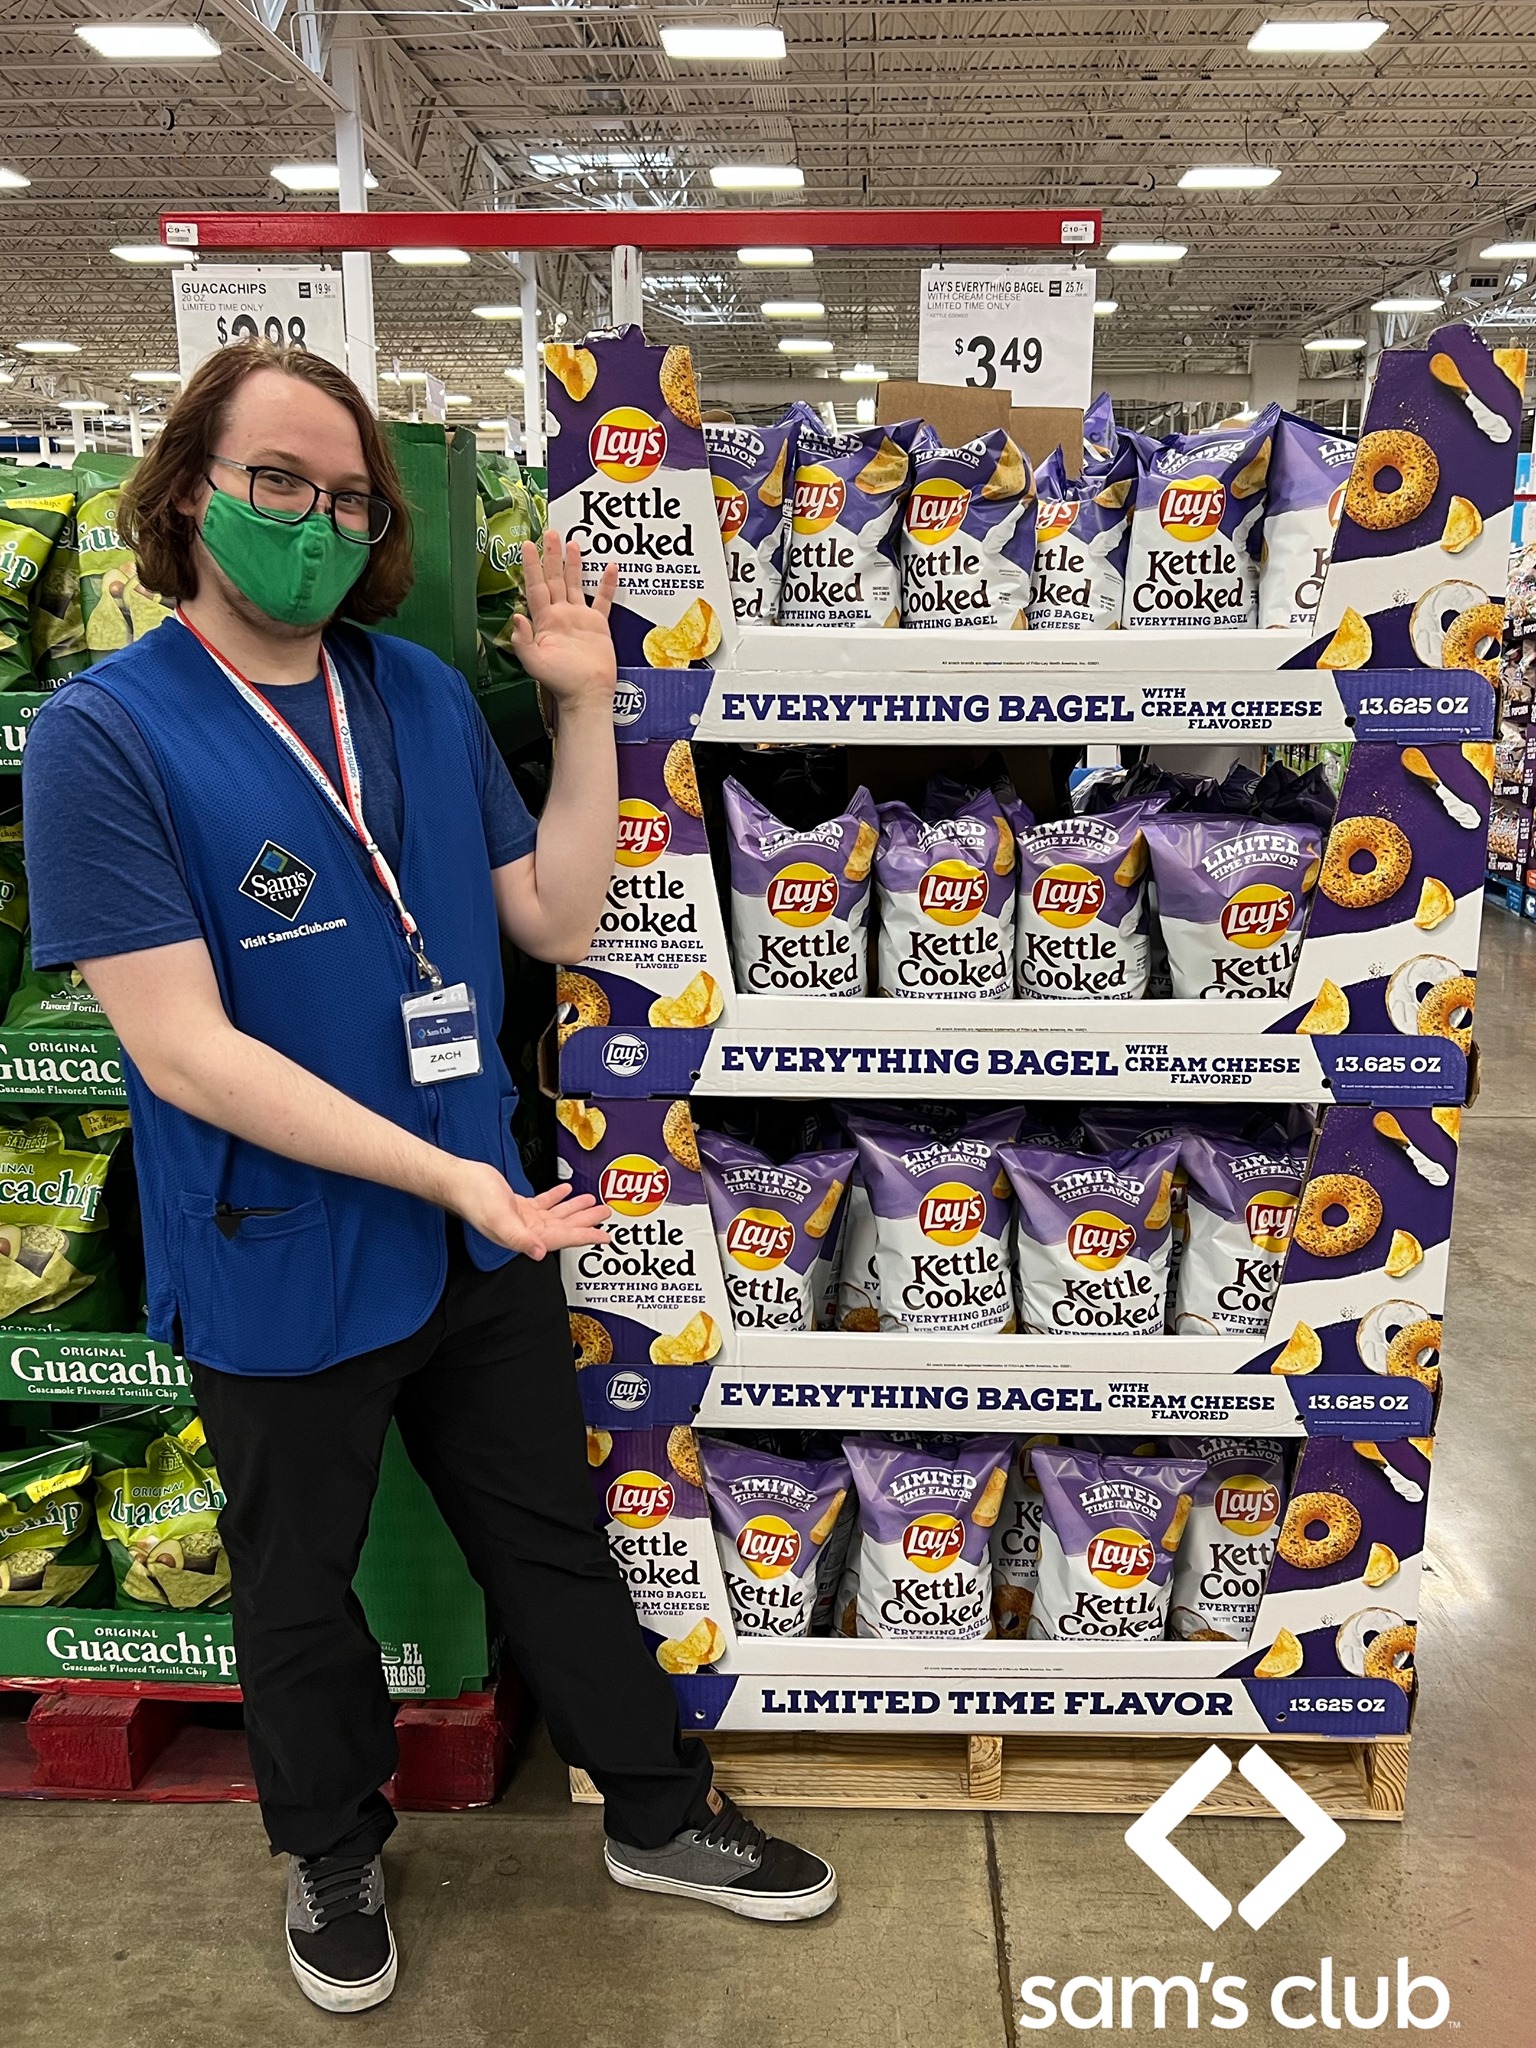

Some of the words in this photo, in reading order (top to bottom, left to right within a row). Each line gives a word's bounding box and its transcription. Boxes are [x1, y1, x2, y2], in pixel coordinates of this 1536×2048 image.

[181, 282, 267, 294] GUACACHIPS
[927, 281, 953, 293] LAY'S
[955, 281, 1012, 293] EVERYTHING
[1014, 282, 1044, 293] BAGEL
[927, 293, 950, 301] WITH
[952, 293, 984, 301] CREAM
[985, 293, 1021, 301] CHEESE
[182, 303, 216, 311] LIMITED
[240, 304, 264, 312] ONLY
[927, 302, 962, 310] LIMITED
[963, 302, 985, 310] TIME
[987, 302, 1011, 310] ONLY
[579, 487, 681, 530] Kettle
[1165, 490, 1224, 527] Lay's
[655, 563, 701, 574] BAGEL
[1147, 545, 1237, 586] Kettle
[652, 578, 705, 590] CHEESE
[1133, 577, 1244, 613] Cooked
[831, 609, 872, 620] BAGEL
[1054, 609, 1095, 622] BAGEL
[1129, 615, 1211, 626] EVERYTHING
[1213, 614, 1248, 625] BAGEL
[1141, 687, 1187, 699] WITH
[722, 692, 989, 723] EVERYTHING
[999, 694, 1135, 723] BAGEL
[1140, 700, 1227, 717] CREAM
[1230, 700, 1323, 717] CHEESE
[1358, 697, 1432, 715] 13.625
[1436, 696, 1470, 715] OZ
[1188, 718, 1273, 729] FLAVORED
[1019, 820, 1120, 845] LIMITED
[1058, 836, 1112, 855] FLAVOR
[1200, 834, 1301, 875] LIMITED
[1210, 860, 1243, 881] TIME
[1244, 852, 1299, 868] FLAVOR
[251, 871, 308, 897] Sam's
[923, 876, 986, 912] Lay's
[771, 878, 835, 914] Lay's
[1037, 880, 1101, 915] Lay's
[1226, 897, 1291, 935] Lay's
[239, 935, 268, 950] Visit
[267, 917, 348, 944] SamsClub.com
[661, 939, 704, 949] BAGEL
[758, 930, 850, 968] Kettle
[909, 926, 999, 967] Kettle
[1024, 932, 1117, 968] Kettle
[607, 953, 655, 962] CREAM
[657, 953, 708, 963] CHEESE
[747, 953, 859, 990] Cooked
[897, 951, 1008, 988] Cooked
[1019, 960, 1127, 994] Cooked
[29, 1042, 98, 1053] ORIGINAL
[430, 1050, 462, 1063] ZACH
[1125, 1044, 1168, 1055] WITH
[721, 1045, 979, 1074] EVERYTHING
[988, 1048, 1119, 1076] BAGEL
[1124, 1056, 1203, 1072] CREAM
[1211, 1057, 1301, 1073] CHEESE
[1334, 1056, 1407, 1073] 13.625
[1410, 1056, 1441, 1073] OZ
[49, 1085, 88, 1095] Flavored
[1170, 1073, 1252, 1085] FLAVORED
[909, 1156, 941, 1176] TIME
[940, 1154, 988, 1170] FLAVOR
[1234, 1168, 1267, 1182] TIME
[721, 1168, 812, 1194] LIMITED
[1050, 1169, 1146, 1196] LIMITED
[727, 1183, 757, 1193] TIME
[757, 1185, 805, 1204] FLAVOR
[1058, 1188, 1083, 1202] TIME
[1088, 1184, 1141, 1206] FLAVOR
[924, 1196, 983, 1233] Lay's
[729, 1219, 792, 1257] Lay's
[1072, 1224, 1133, 1258] Lay's
[577, 1248, 696, 1280] Cooked
[910, 1247, 1000, 1288] Kettle
[575, 1282, 659, 1291] EVERYTHING
[660, 1282, 703, 1291] BAGEL
[901, 1270, 1008, 1311] Cooked
[1062, 1270, 1153, 1308] Kettle
[610, 1295, 656, 1304] CREAM
[658, 1295, 706, 1304] CHEESE
[901, 1311, 979, 1323] EVERYTHING
[1052, 1294, 1160, 1329] Cooked
[59, 1346, 127, 1358] ORIGINAL
[27, 1385, 75, 1396] Guacamole
[76, 1386, 116, 1397] Flavored
[117, 1387, 153, 1397] Tortilla
[155, 1389, 178, 1400] Chip
[720, 1382, 969, 1410] EVERYTHING
[977, 1385, 1102, 1412] BAGEL
[1108, 1383, 1149, 1393] WITH
[1107, 1394, 1186, 1409] CREAM
[1190, 1395, 1275, 1410] CHEESE
[1308, 1394, 1375, 1410] 13.625
[1379, 1395, 1409, 1410] OZ
[1151, 1410, 1229, 1421] FLAVORED
[729, 1479, 819, 1504] LIMITED
[889, 1472, 978, 1498] LIMITED
[734, 1491, 766, 1504] TIME
[896, 1489, 926, 1506] TIME
[926, 1487, 973, 1501] FLAVOR
[1220, 1489, 1277, 1523] Lay's
[1085, 1500, 1115, 1516] TIME
[740, 1527, 799, 1566] Lay's
[908, 1524, 963, 1560] Lay's
[1090, 1540, 1153, 1576] Lay's
[666, 1590, 707, 1599] BAGEL
[891, 1572, 978, 1609] Kettle
[663, 1602, 710, 1611] CHEESE
[880, 1591, 985, 1627] Cooked
[1058, 1605, 1164, 1638] Cooked
[93, 1627, 159, 1639] ORIGINAL
[45, 1627, 238, 1678] Guacachip
[402, 1643, 423, 1665] EL
[61, 1662, 108, 1673] Guacamole
[109, 1663, 148, 1674] Flavored
[148, 1664, 184, 1675] Tortilla
[185, 1665, 208, 1678] Chip
[761, 1689, 941, 1715] LIMITED
[948, 1691, 1055, 1716] TIME
[1063, 1691, 1234, 1716] FLAVOR
[1289, 1698, 1353, 1713] 13.625
[1356, 1699, 1386, 1713] OZ
